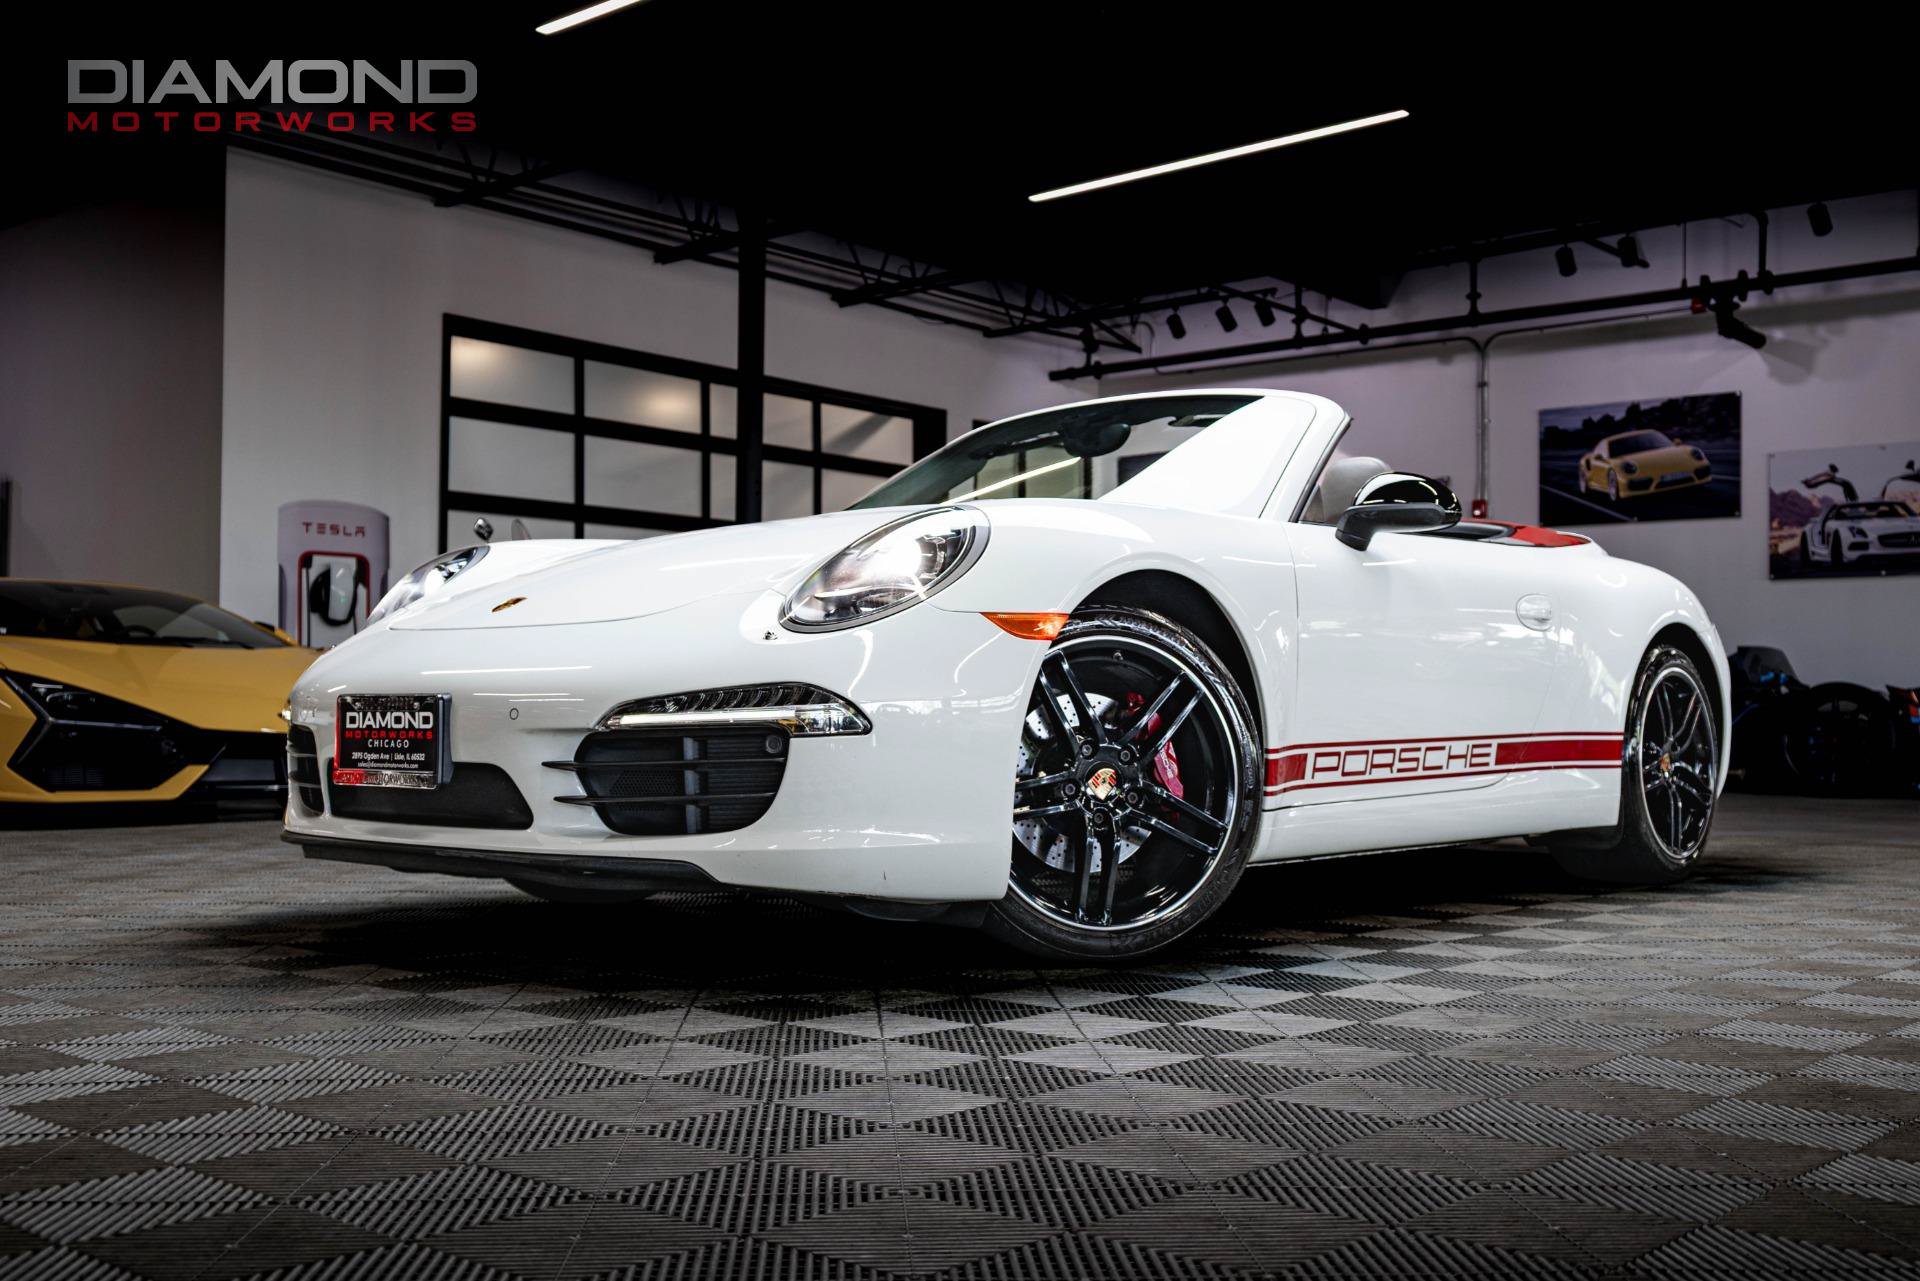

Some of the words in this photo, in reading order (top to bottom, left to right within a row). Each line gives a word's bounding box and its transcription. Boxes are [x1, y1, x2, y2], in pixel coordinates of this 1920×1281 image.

[302, 521, 366, 537] TESLA
[346, 712, 434, 728] DIAMOND
[345, 730, 432, 740] MOTORWORKS
[368, 740, 410, 748] CHICAGO
[363, 752, 380, 761] Ogden
[380, 752, 390, 760] Ave
[1311, 743, 1493, 780] PORSCHE
